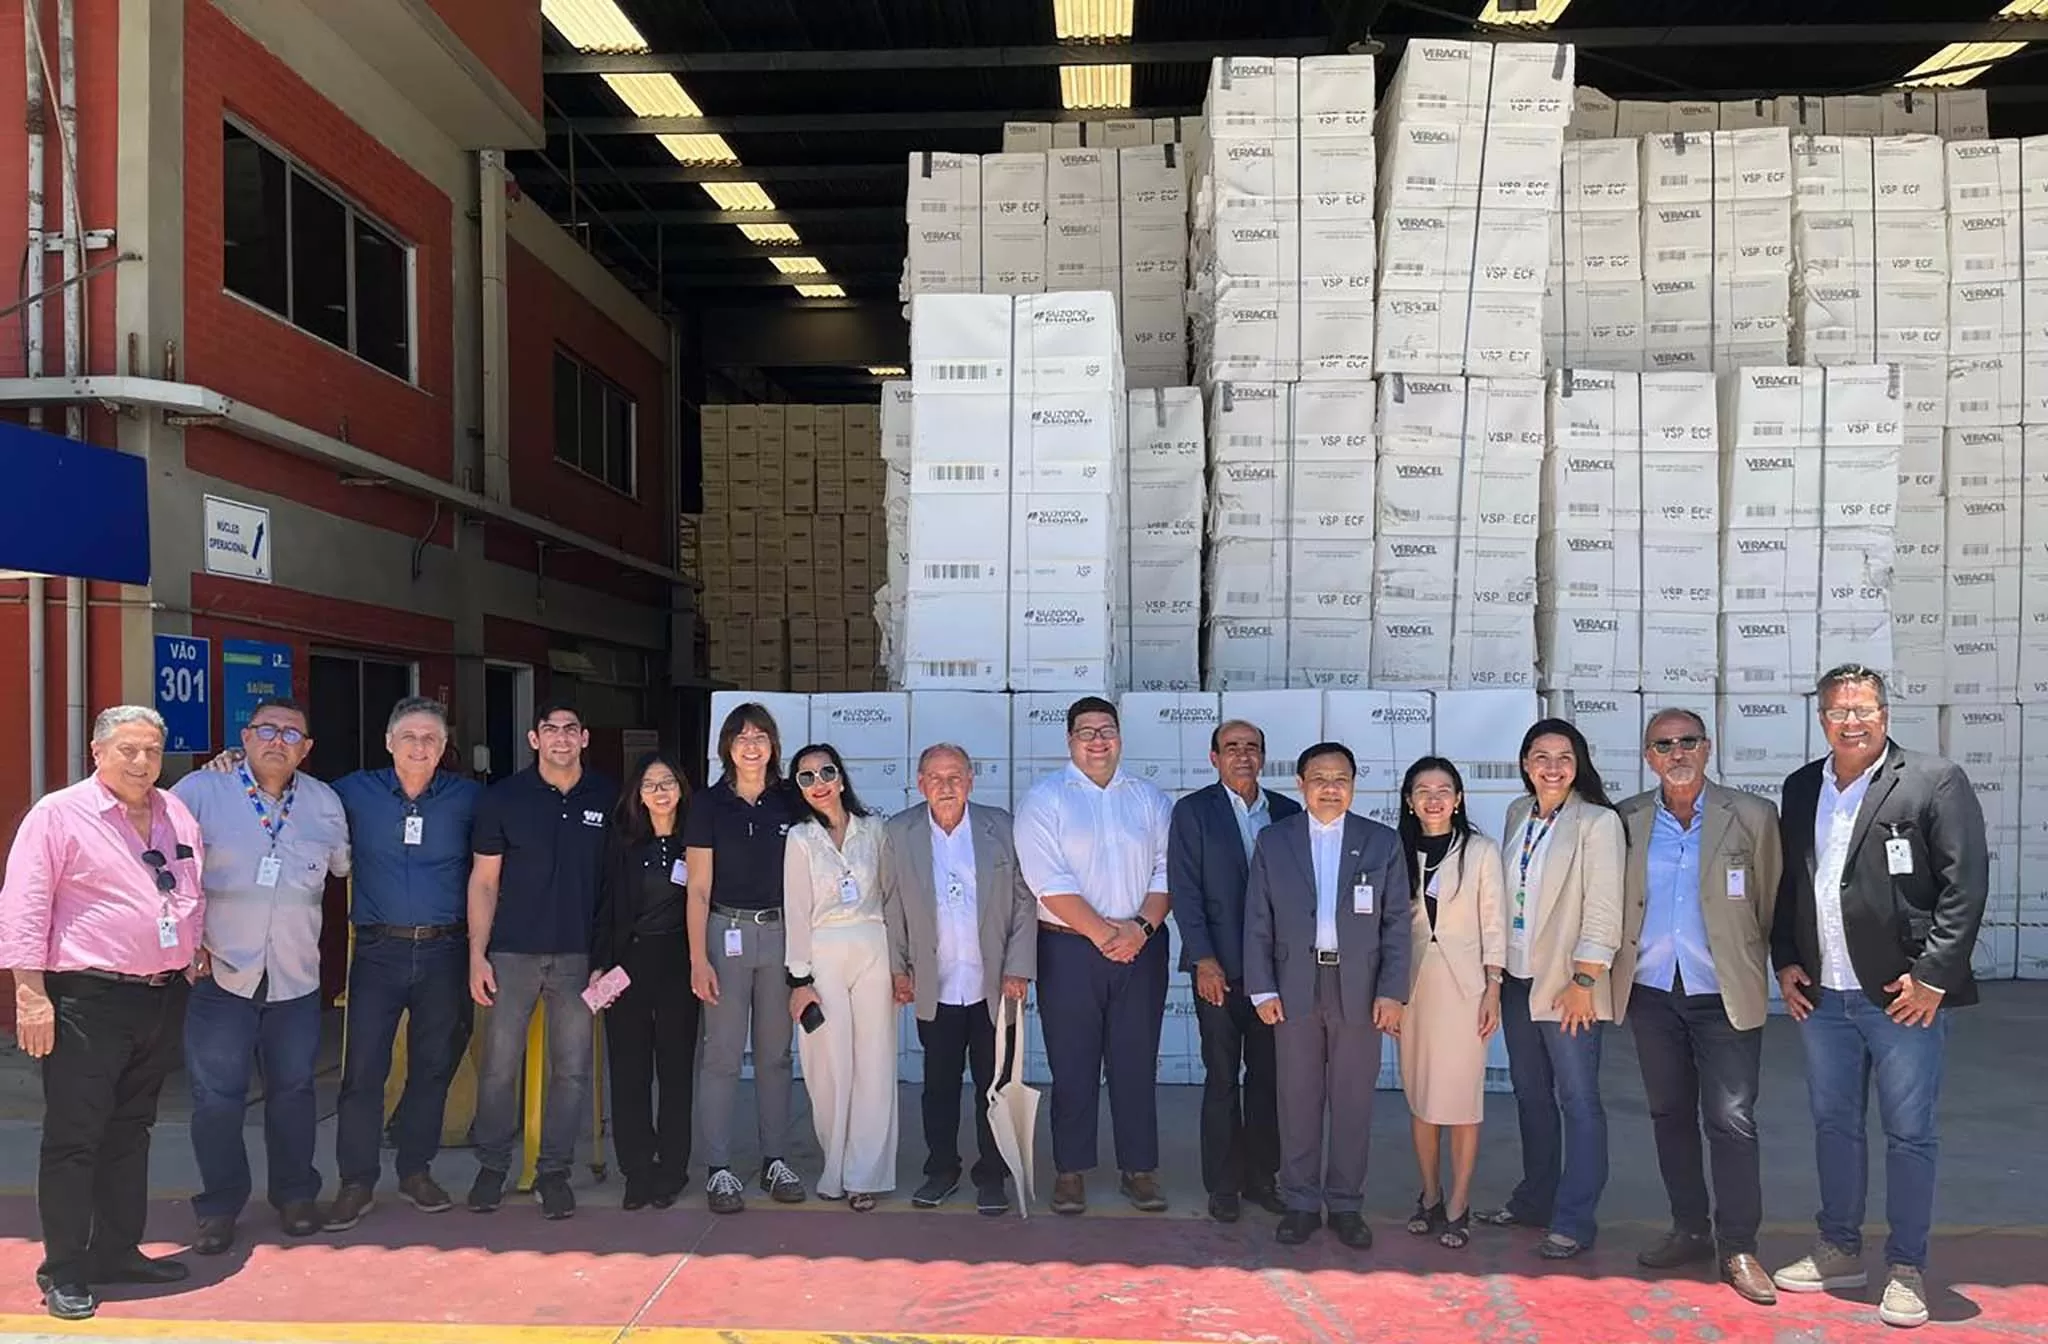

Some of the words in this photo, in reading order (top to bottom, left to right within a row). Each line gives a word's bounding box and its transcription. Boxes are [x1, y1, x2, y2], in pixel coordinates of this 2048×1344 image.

[1660, 137, 1701, 146] VECEL
[933, 159, 963, 168] RACEL
[1742, 173, 1760, 182] VSP
[1767, 173, 1786, 182] ECF
[1880, 185, 1897, 193] VSP
[1904, 185, 1920, 194] ECF
[1233, 229, 1279, 239] VERACEL
[1741, 248, 1760, 256] VSP
[1766, 247, 1785, 256] ECF
[1892, 260, 1911, 268] VSP
[1916, 259, 1933, 267] ECF
[1322, 278, 1343, 287] VSP
[1350, 276, 1370, 287] ECF
[1233, 310, 1279, 319] VERACEL
[1900, 332, 1918, 341] VSP
[1924, 331, 1941, 341] ECF
[1752, 376, 1801, 385] VERACEL
[1407, 383, 1452, 392] VERACEL
[1847, 423, 1869, 433] VSP
[1876, 423, 1898, 432] ECF
[1320, 436, 1340, 446] VSP
[1348, 436, 1367, 445] ECF
[1488, 432, 1512, 442] VSP
[1521, 433, 1544, 443] ECF
[1569, 460, 1615, 470] VERACEL
[1746, 458, 1794, 468] VERACEL
[1396, 466, 1444, 476] VERACEL
[1916, 476, 1934, 484] ECF
[1841, 505, 1863, 514] VSP
[1870, 504, 1892, 514] ECF
[1319, 516, 1339, 525] VSP
[1345, 516, 1364, 525] ECF
[1481, 514, 1504, 523] VSP
[1513, 514, 1536, 524] ECF
[1391, 544, 1437, 554] VERACEL
[1568, 539, 1614, 549] VERACEL
[1737, 540, 1787, 550] VERACEL
[1474, 592, 1499, 602] VSP
[1508, 592, 1533, 601] ECF
[1831, 588, 1853, 598] VSP
[1861, 588, 1883, 599] ECF
[1318, 595, 1336, 605] VSP
[1343, 595, 1364, 605] ECF
[1574, 619, 1619, 630] VERACEL
[1387, 626, 1433, 635] VERACEL
[1738, 625, 1786, 635] VERACEL
[170, 641, 196, 660] VÃO
[1314, 674, 1334, 684] VSP
[1340, 674, 1359, 684] ECF
[1472, 672, 1495, 682] VSP
[1504, 672, 1528, 682] ECF
[161, 667, 204, 703] 301
[1574, 701, 1618, 711] VERACEL
[1738, 704, 1788, 714] VERACEL
